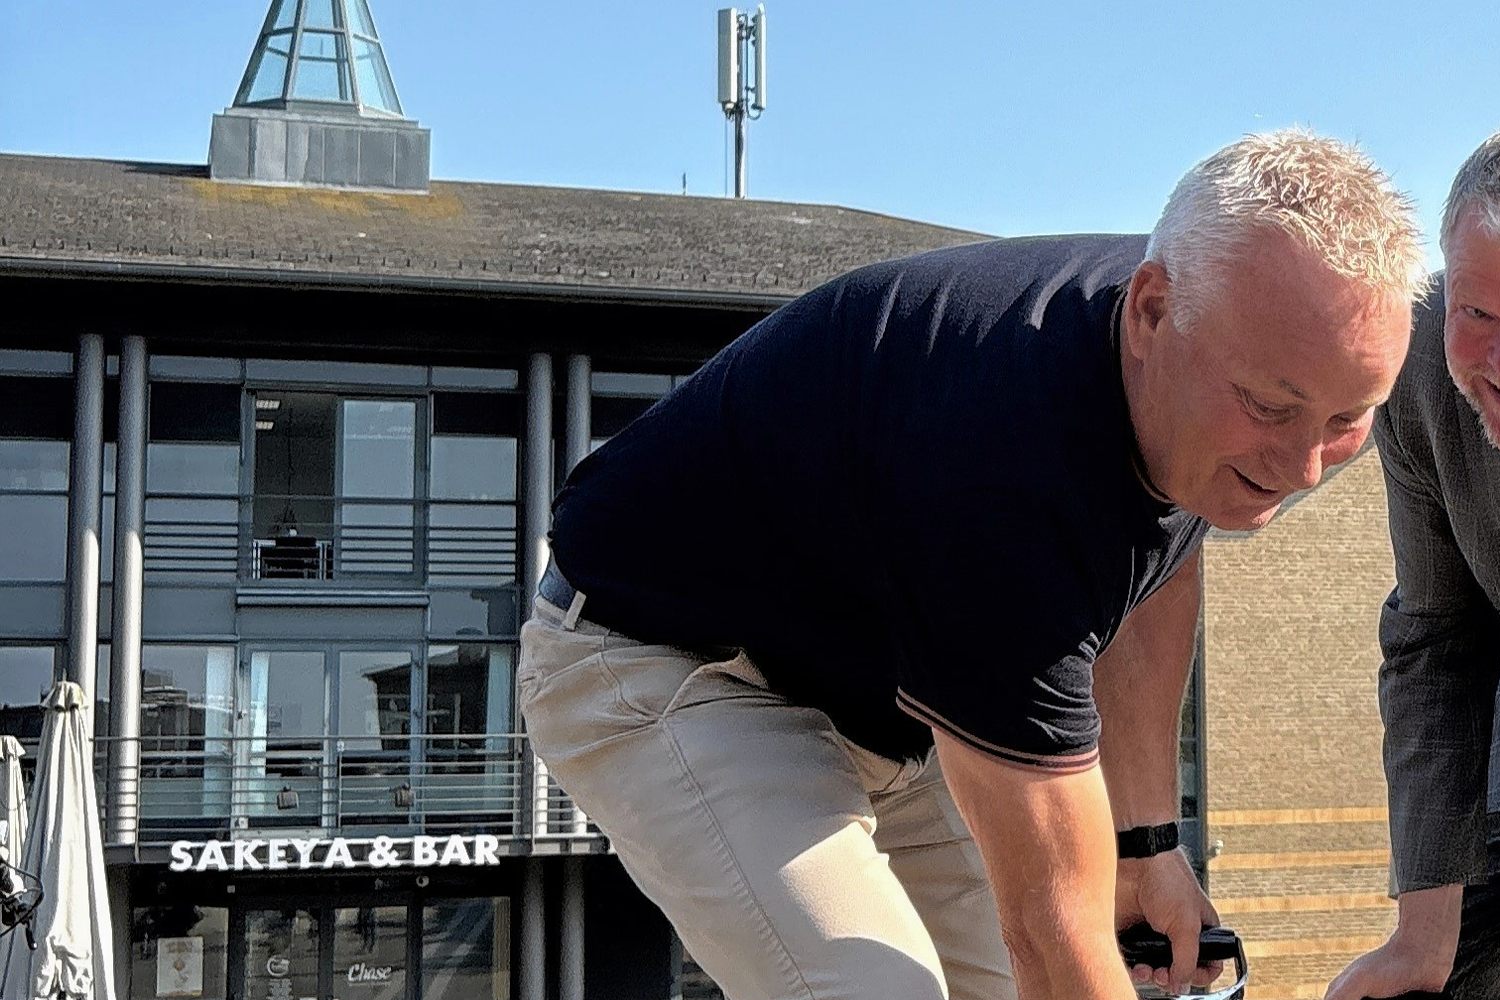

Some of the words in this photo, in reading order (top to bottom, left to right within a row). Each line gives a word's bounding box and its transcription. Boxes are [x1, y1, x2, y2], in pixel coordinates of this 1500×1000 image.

[169, 837, 356, 872] SAKEYA
[368, 835, 400, 868] &
[413, 834, 501, 867] BAR
[347, 962, 393, 983] Chase
